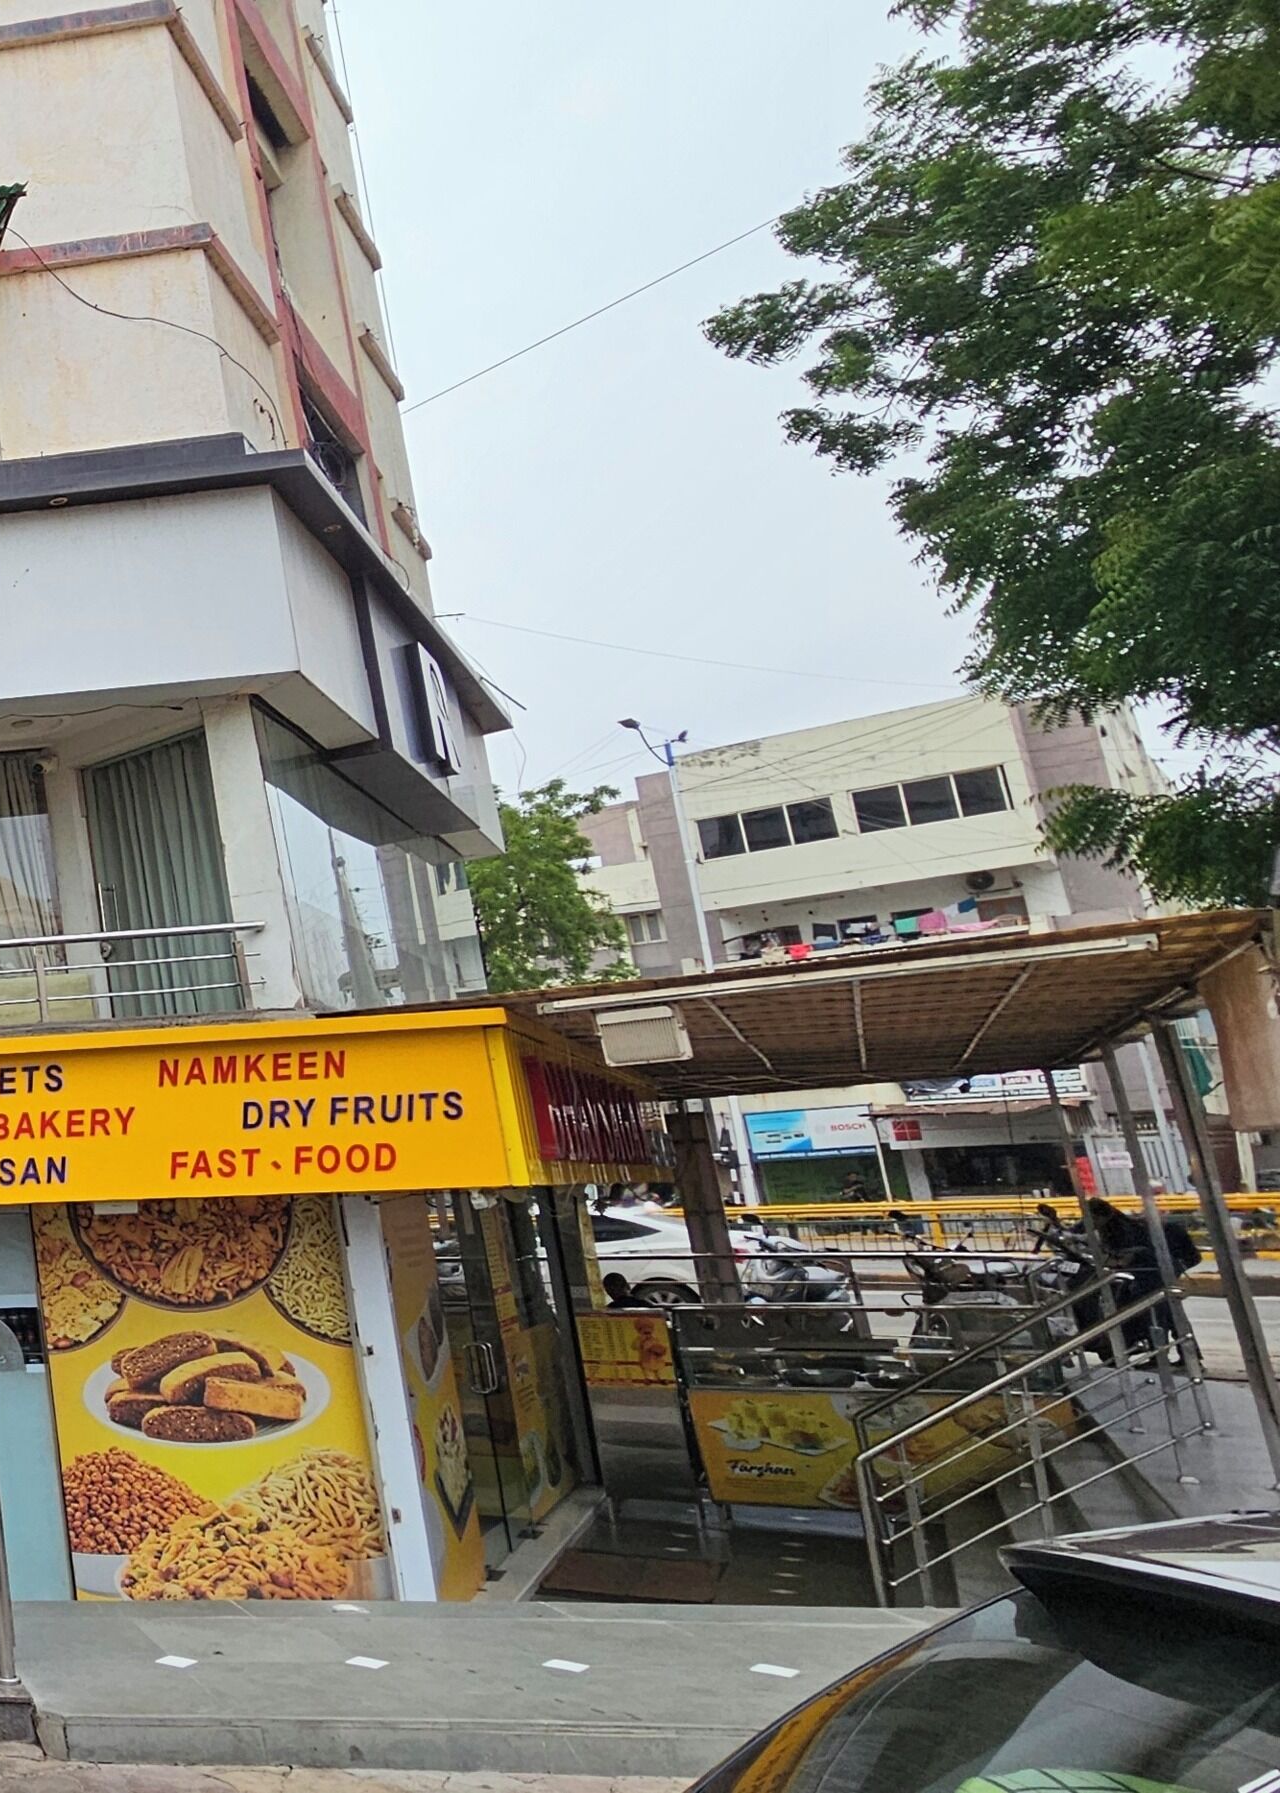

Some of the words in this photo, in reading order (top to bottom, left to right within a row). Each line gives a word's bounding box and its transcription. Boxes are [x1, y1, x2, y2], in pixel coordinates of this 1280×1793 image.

[157, 1049, 347, 1088] NAMKEEN
[241, 1096, 318, 1131] DRY
[328, 1090, 464, 1125] FRUITS
[829, 1122, 867, 1132] BOSCH
[169, 1147, 262, 1180] FAST
[293, 1142, 398, 1175] FOOD
